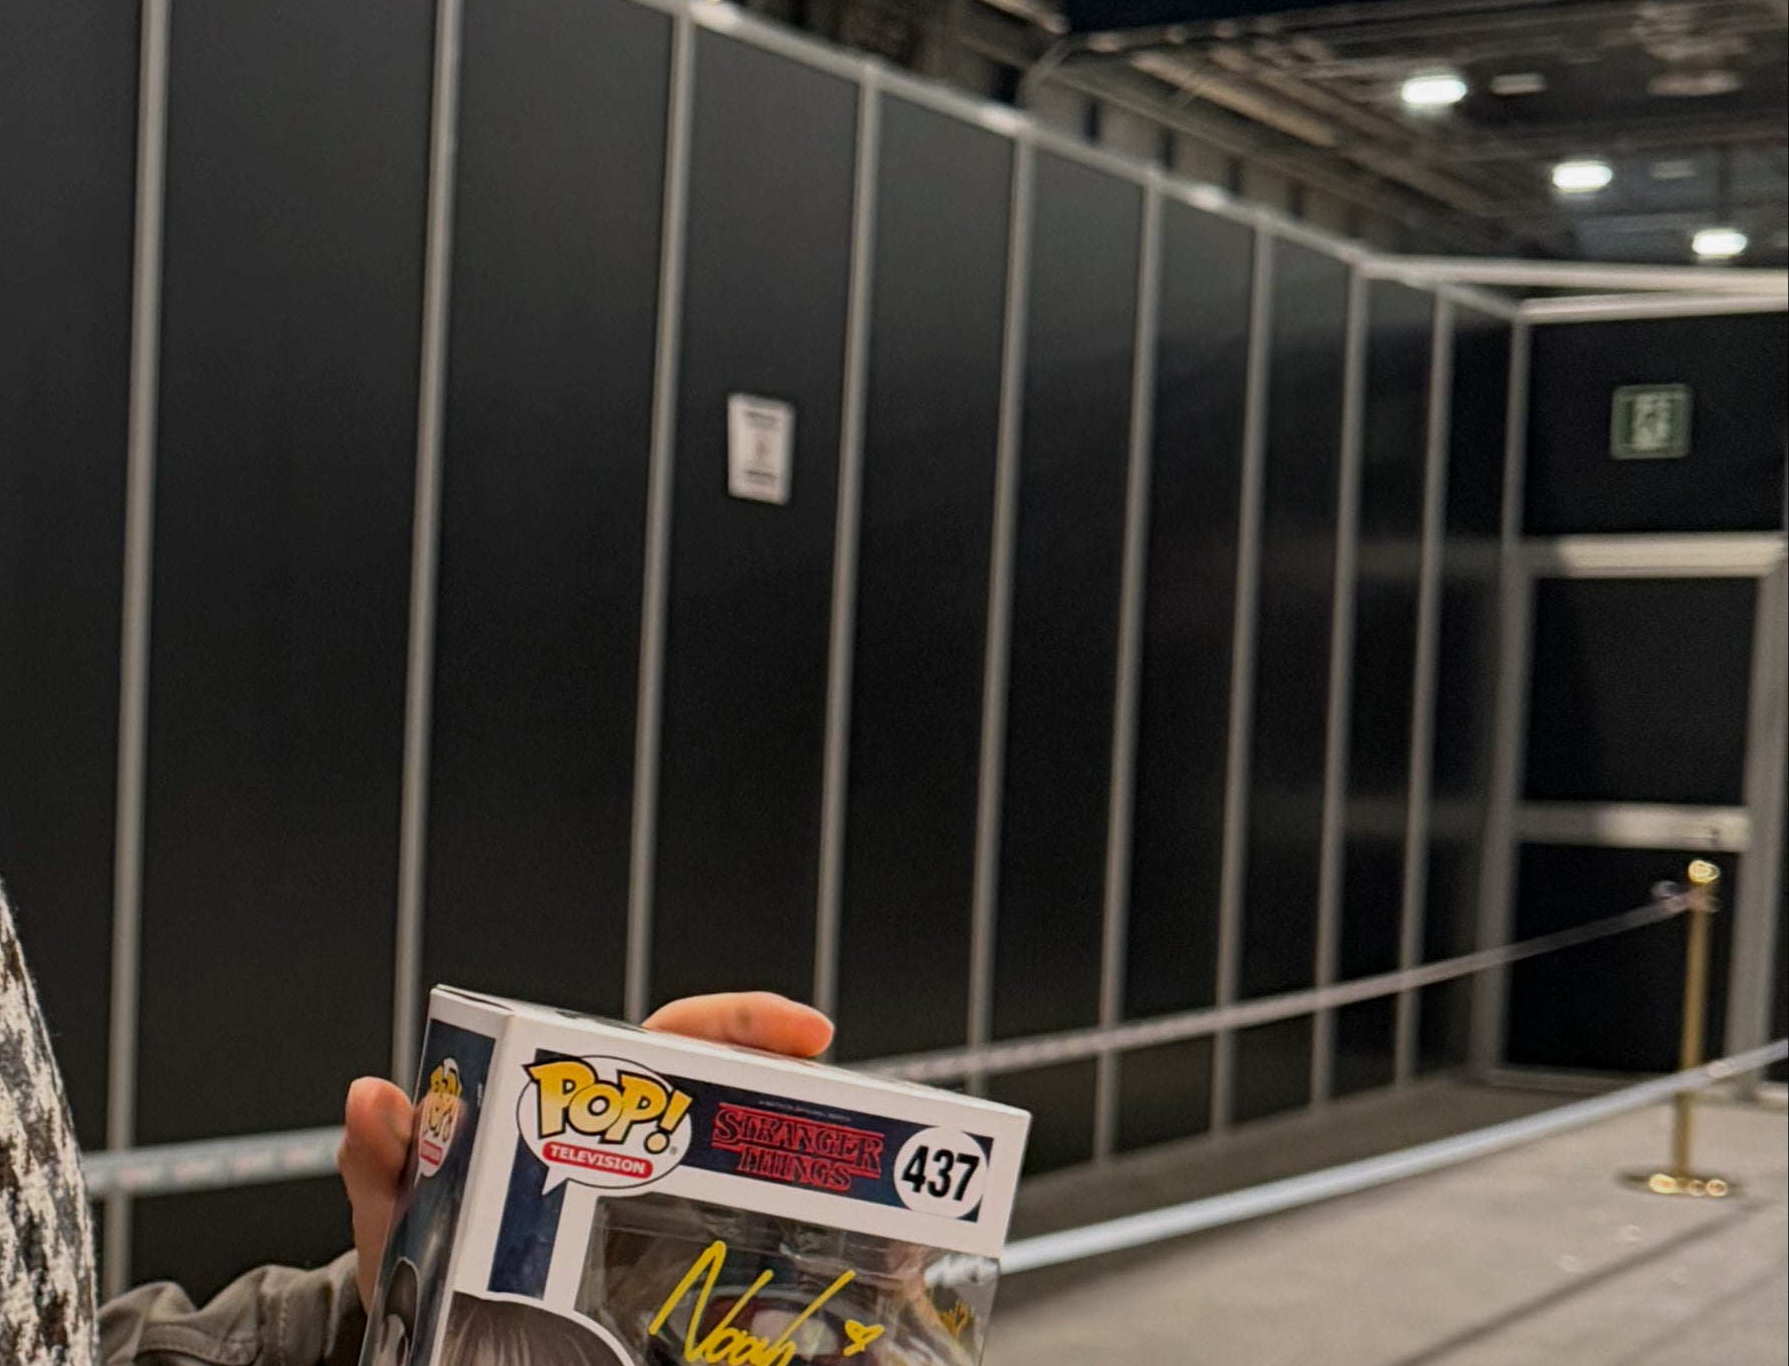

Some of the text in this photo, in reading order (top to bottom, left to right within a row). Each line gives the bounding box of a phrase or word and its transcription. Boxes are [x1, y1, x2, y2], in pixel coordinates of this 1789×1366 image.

[522, 1059, 694, 1155] POP!
[549, 1144, 647, 1174] TELEVISION
[712, 1102, 884, 1179] STRANGER
[737, 1146, 852, 1193] THINGS
[901, 1144, 980, 1202] 437
